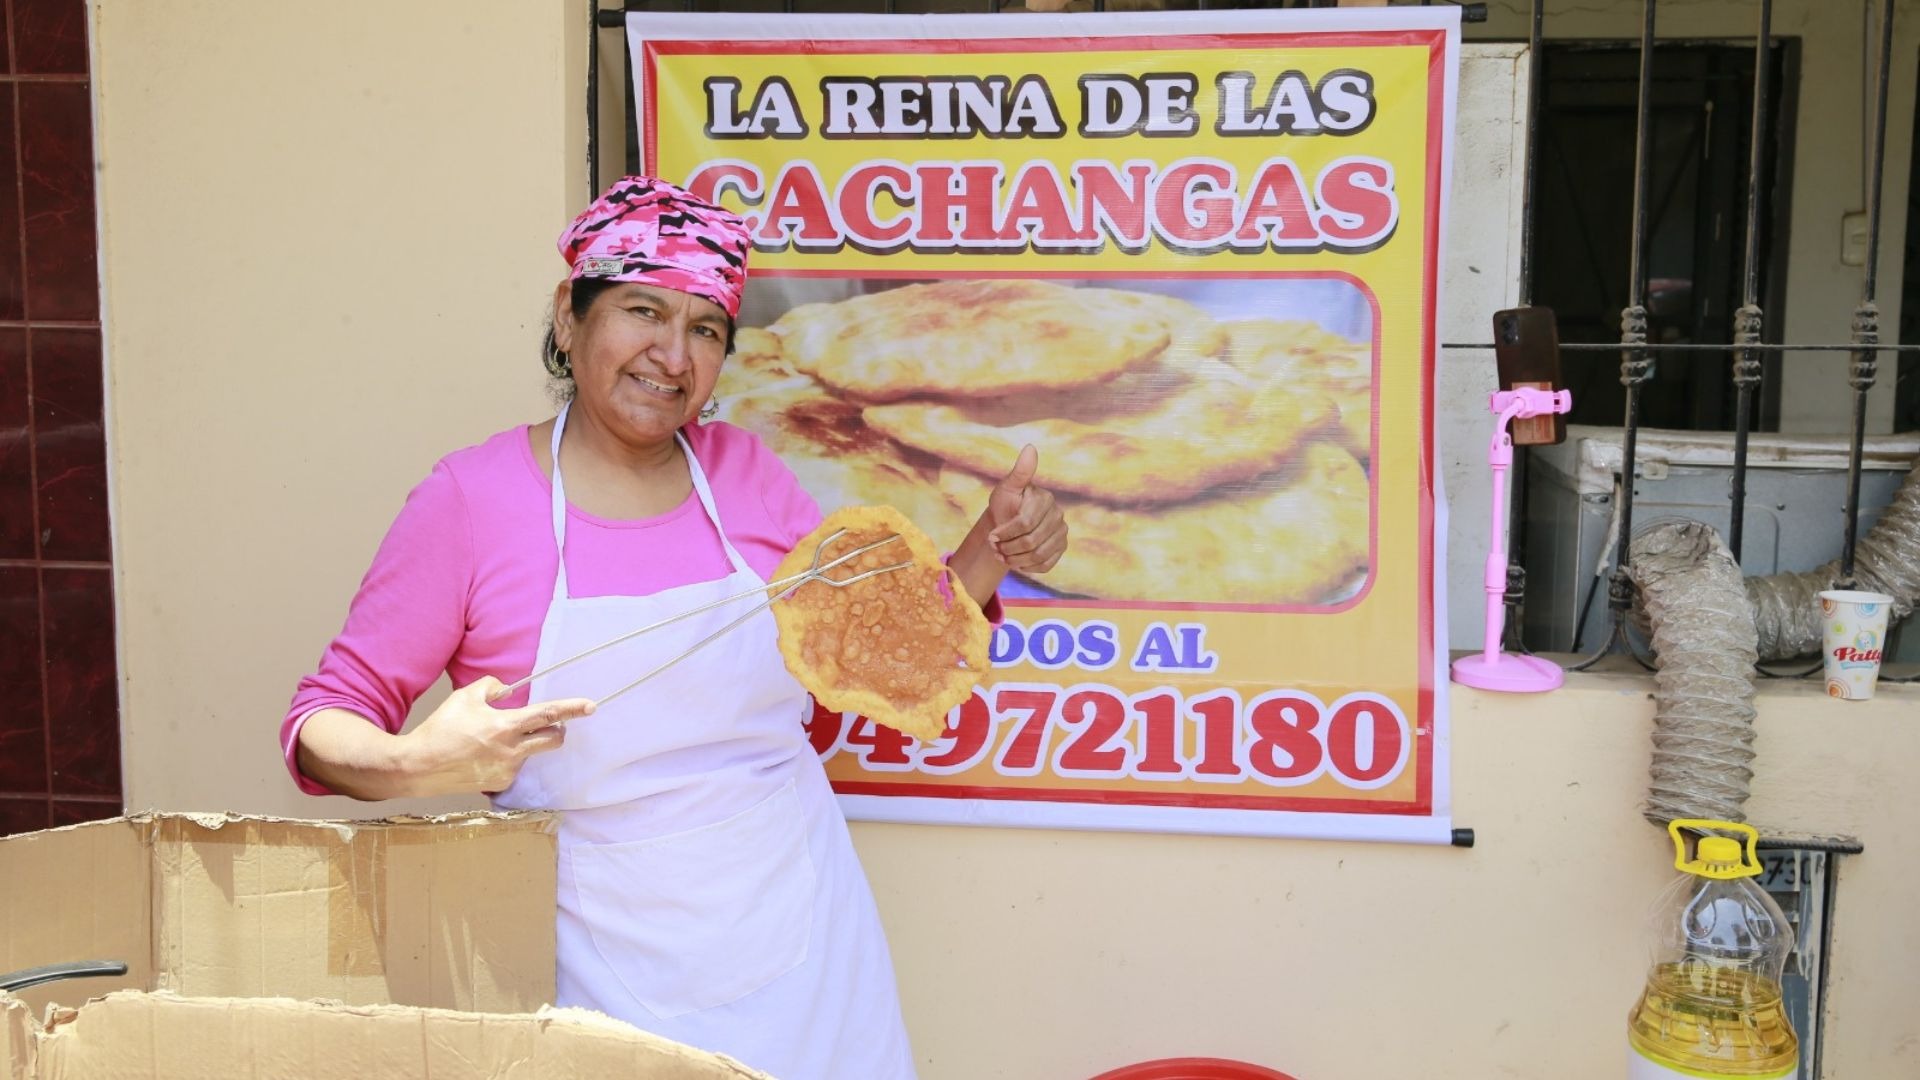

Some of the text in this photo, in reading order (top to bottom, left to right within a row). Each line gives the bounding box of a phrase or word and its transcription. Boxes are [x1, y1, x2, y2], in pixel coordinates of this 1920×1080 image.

[709, 72, 1370, 135] LA REINA DE LAS
[687, 162, 1391, 241] CACHANGAS
[1134, 626, 1214, 669] AL
